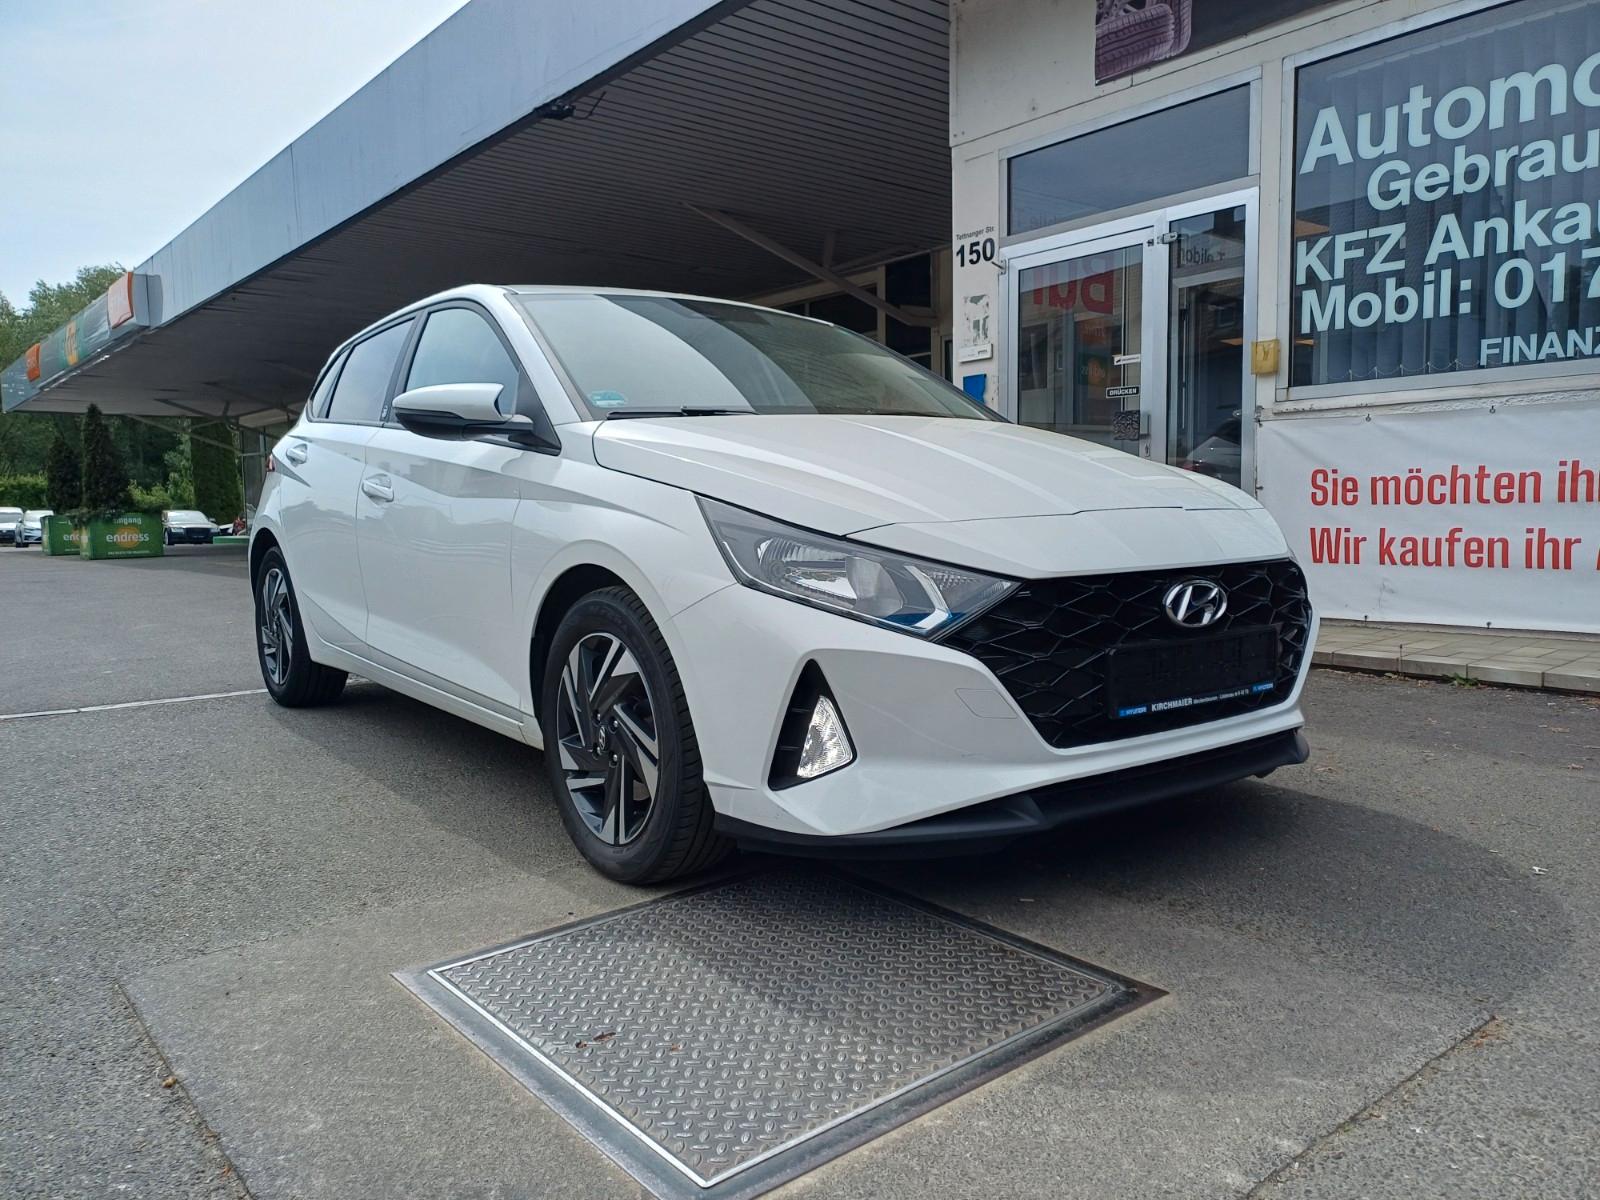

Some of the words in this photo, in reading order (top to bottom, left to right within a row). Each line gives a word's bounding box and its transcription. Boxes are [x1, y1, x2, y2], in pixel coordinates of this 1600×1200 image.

[1367, 128, 1600, 211] Gebrau
[956, 237, 995, 268] 150
[1296, 222, 1406, 286] KFZ
[1424, 198, 1600, 265] Anka
[1301, 268, 1472, 334] Mobil:
[1480, 326, 1600, 366] FINAN
[1109, 387, 1137, 396] DRÜCKEN
[1311, 469, 1358, 506] Sie
[1370, 465, 1541, 505] möchten
[1557, 460, 1600, 503] ih
[106, 532, 150, 543] endress
[1310, 528, 1367, 565] Wir
[1379, 528, 1509, 569] kaufen
[1525, 528, 1581, 570] ihr
[1151, 697, 1193, 712] KIRCHMAIER
